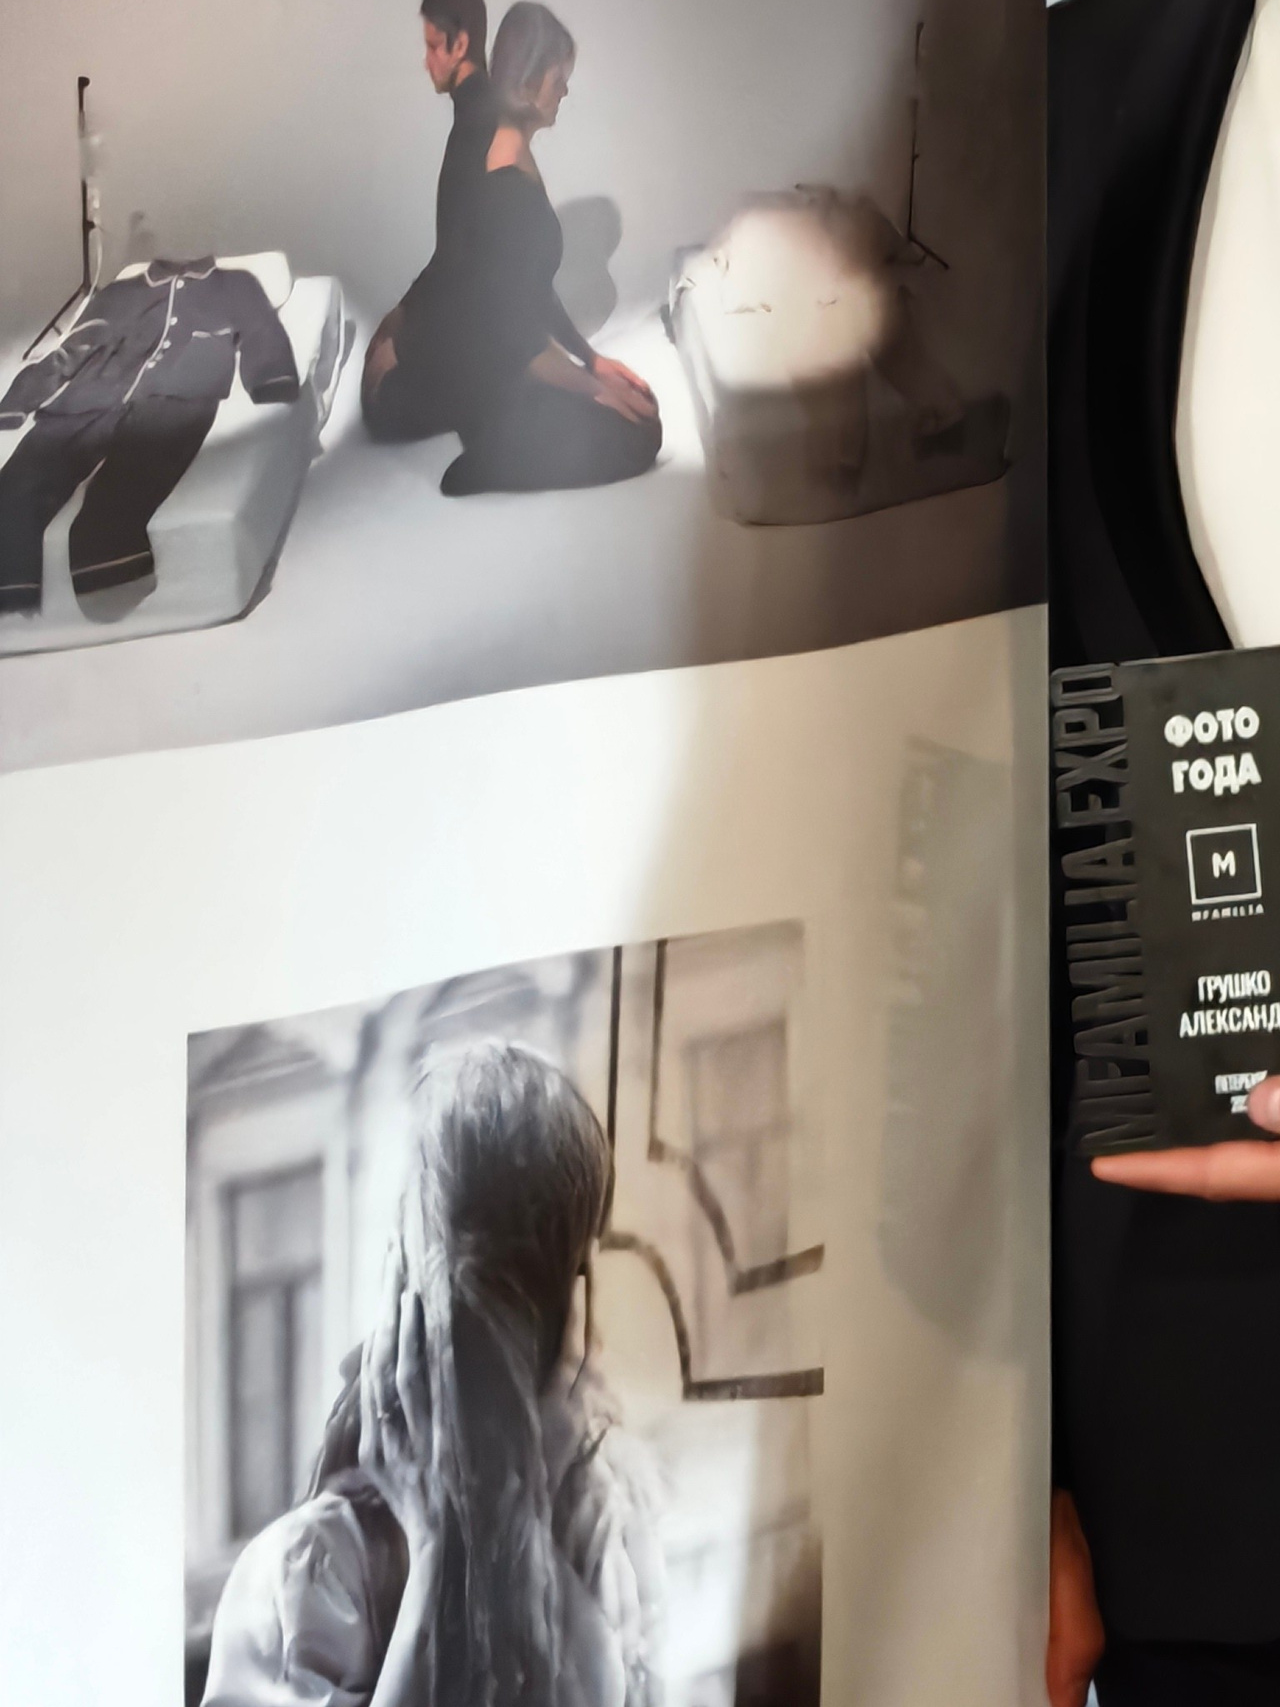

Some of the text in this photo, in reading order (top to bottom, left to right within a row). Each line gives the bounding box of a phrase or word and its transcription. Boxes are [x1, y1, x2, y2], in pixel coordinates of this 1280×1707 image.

[1050, 662, 1133, 830] EXPO
[1164, 705, 1260, 748] ФОТО
[1171, 751, 1262, 796] ГОДА
[1212, 850, 1236, 879] M
[1198, 969, 1271, 1004] ГРУШКО
